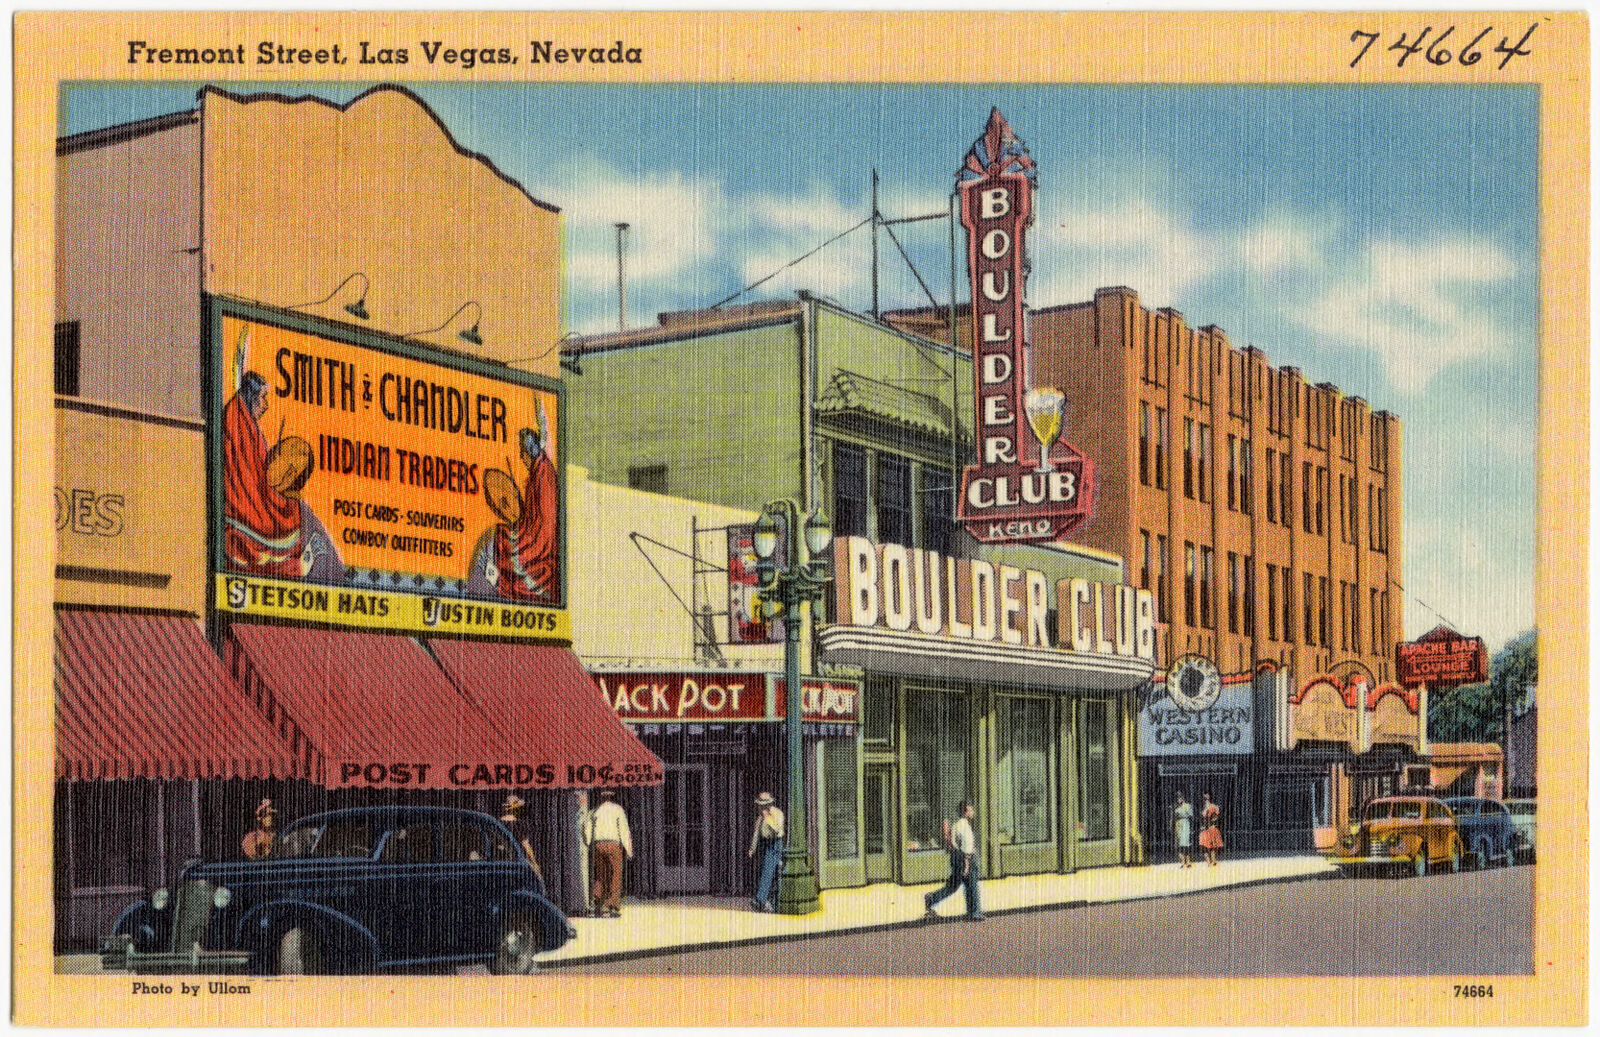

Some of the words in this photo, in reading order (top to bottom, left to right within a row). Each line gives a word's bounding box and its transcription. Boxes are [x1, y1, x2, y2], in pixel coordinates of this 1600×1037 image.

[1350, 22, 1539, 70] 74664
[980, 187, 1018, 465] BOULDER
[275, 347, 356, 413] SMITH
[379, 372, 507, 443] CHANDLER
[319, 433, 390, 482] INDIAN
[396, 447, 479, 495] TRADERS
[967, 471, 1076, 509] CLUB
[333, 498, 362, 518] POST
[364, 503, 399, 523] CARDS
[406, 510, 465, 533] SOUVENIRS
[342, 527, 389, 549] COWBOY
[391, 534, 453, 558] OUTFITTERS
[225, 576, 329, 617] STETSON
[337, 593, 389, 617] HATS
[422, 597, 494, 628] JUSTIN
[500, 602, 557, 631] BOOTS
[847, 536, 1049, 648] BOULDER
[1068, 578, 1155, 659] CLUB
[677, 677, 745, 717] POT
[1147, 706, 1251, 725] WESTERN
[1155, 726, 1241, 746] CASINO
[341, 763, 431, 785] POST
[450, 763, 555, 785] CARDS
[624, 764, 652, 774] PER
